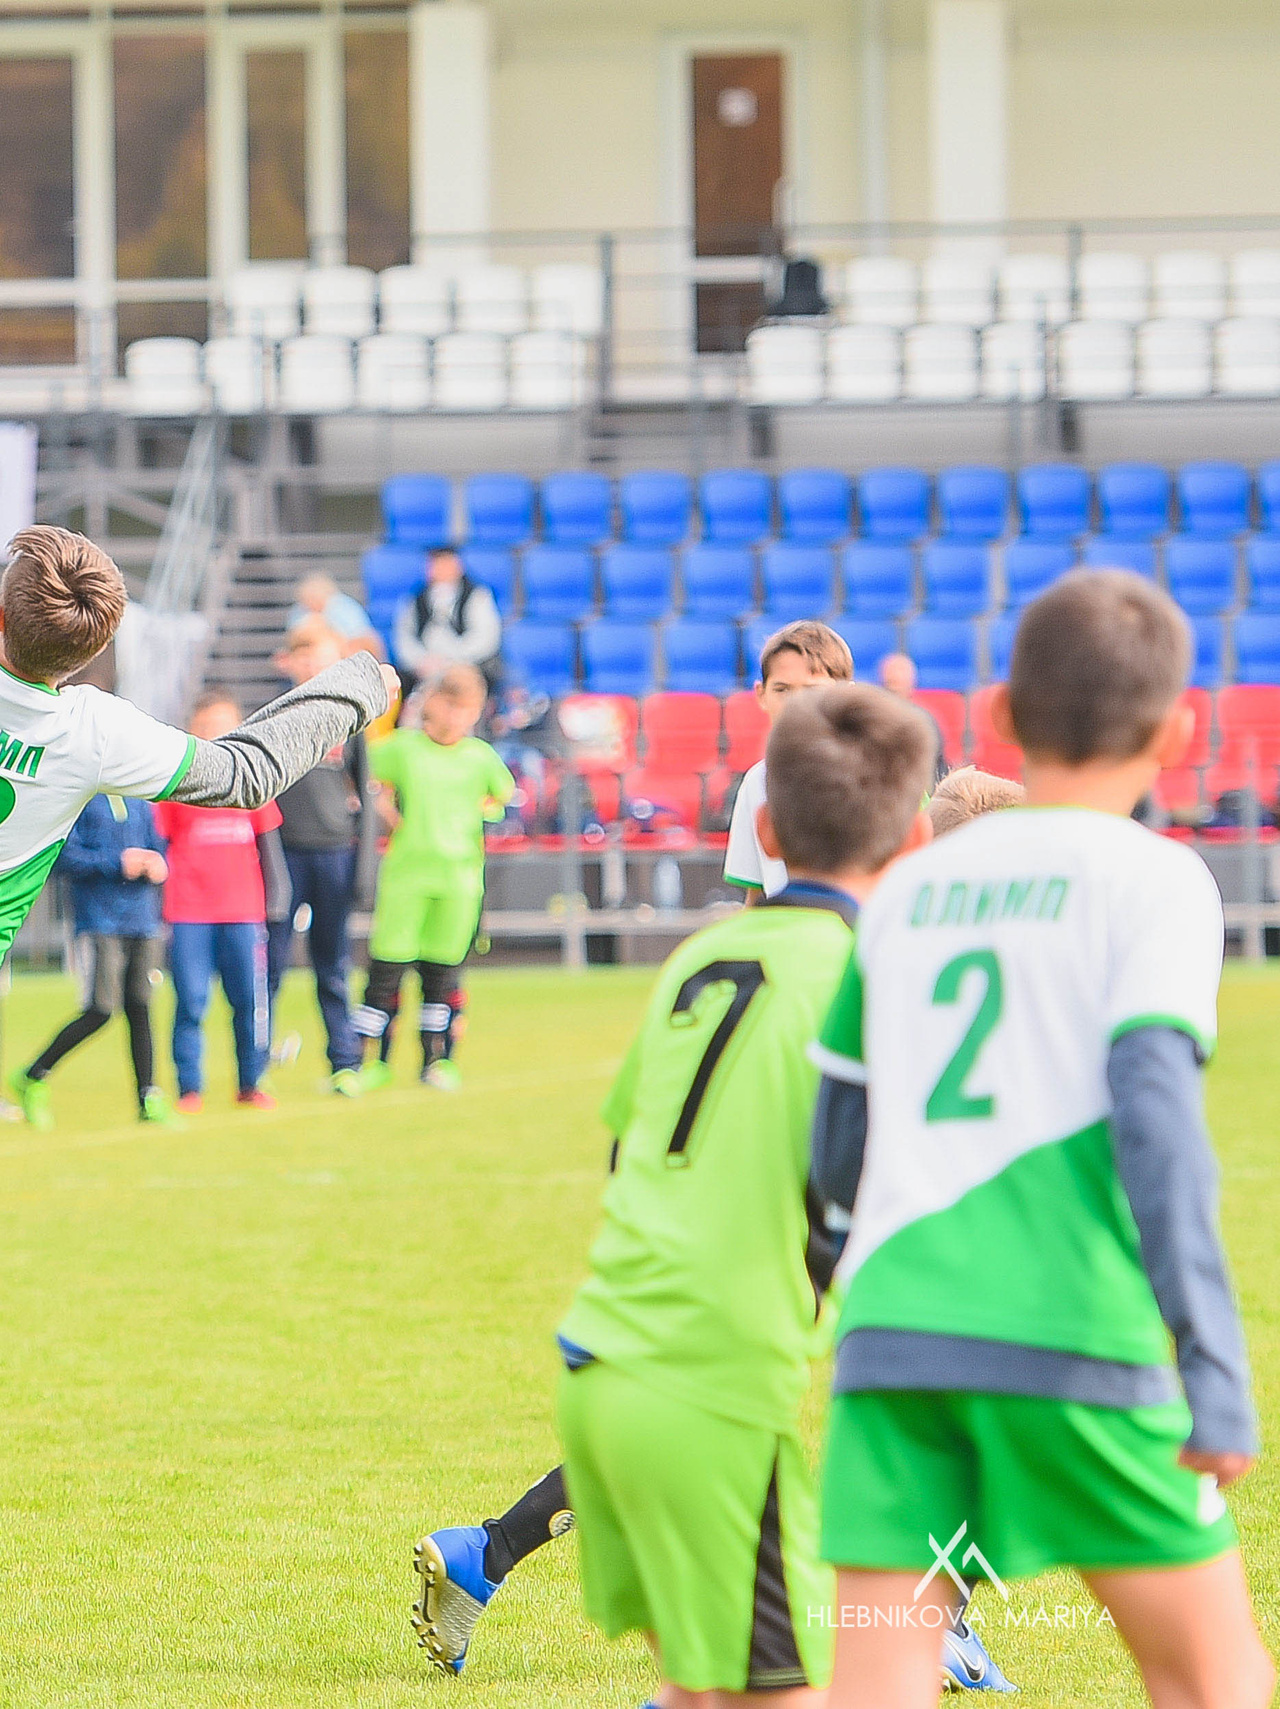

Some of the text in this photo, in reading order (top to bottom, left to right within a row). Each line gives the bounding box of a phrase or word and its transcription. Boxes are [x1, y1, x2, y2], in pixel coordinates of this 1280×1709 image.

[910, 876, 1068, 929] ОЛИМП
[666, 959, 767, 1167] 7
[926, 947, 1003, 1124] 2
